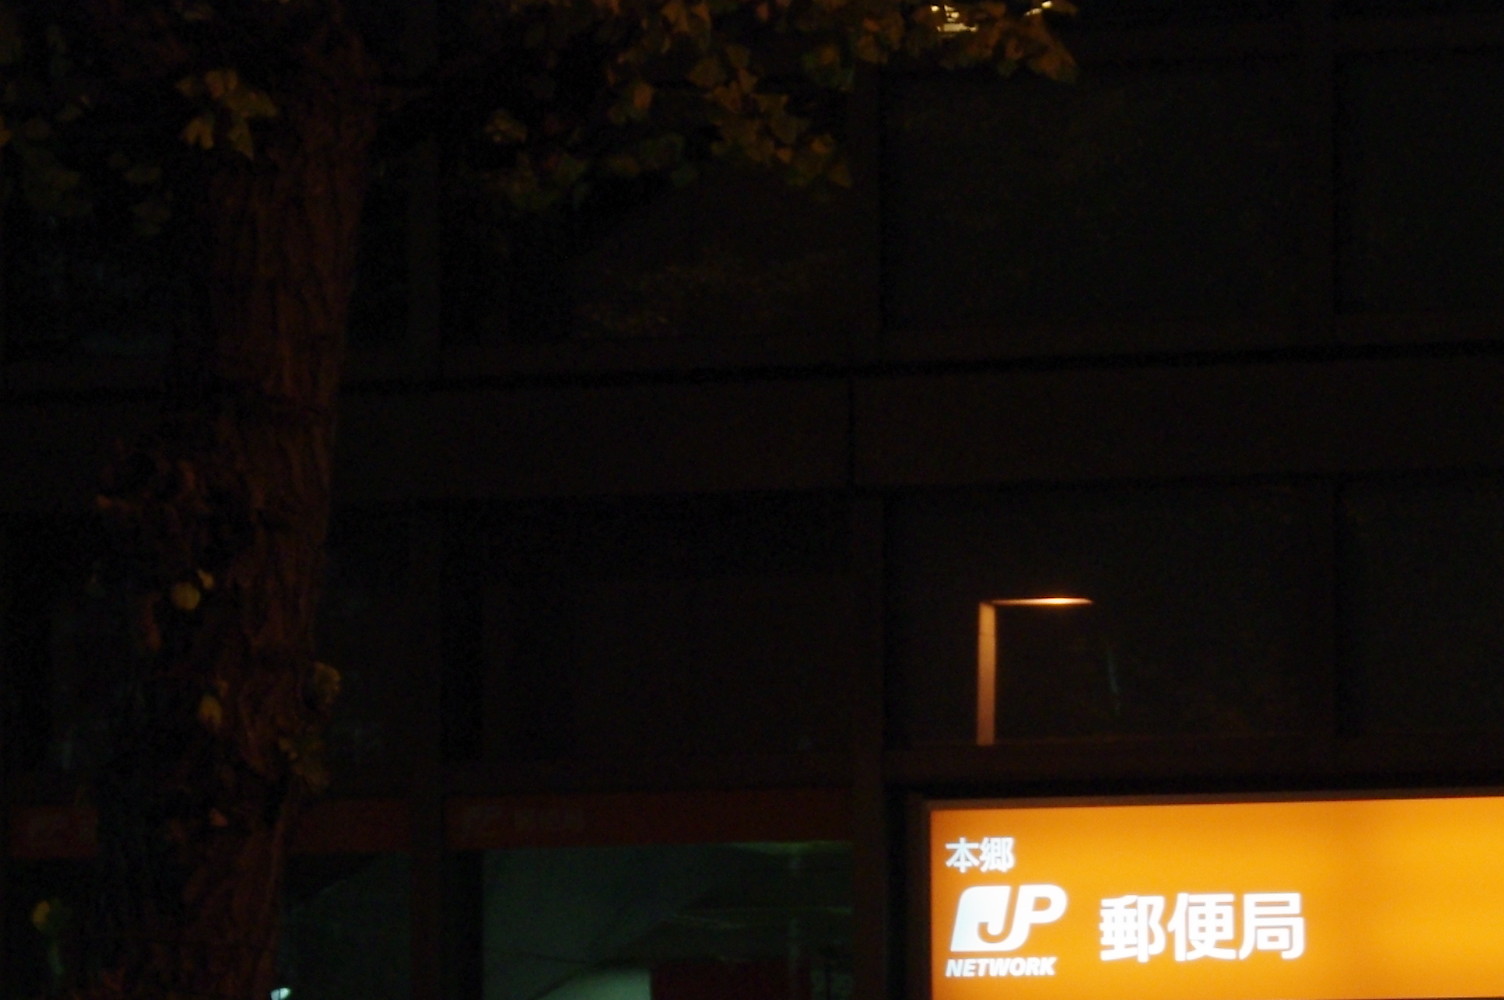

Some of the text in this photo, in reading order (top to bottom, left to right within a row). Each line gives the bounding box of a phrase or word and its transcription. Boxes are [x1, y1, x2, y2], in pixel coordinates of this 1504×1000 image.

[945, 837, 1015, 873] 本郷
[950, 884, 1068, 952] JP
[1099, 892, 1305, 963] 郵便局
[945, 956, 1057, 977] NETWORK
